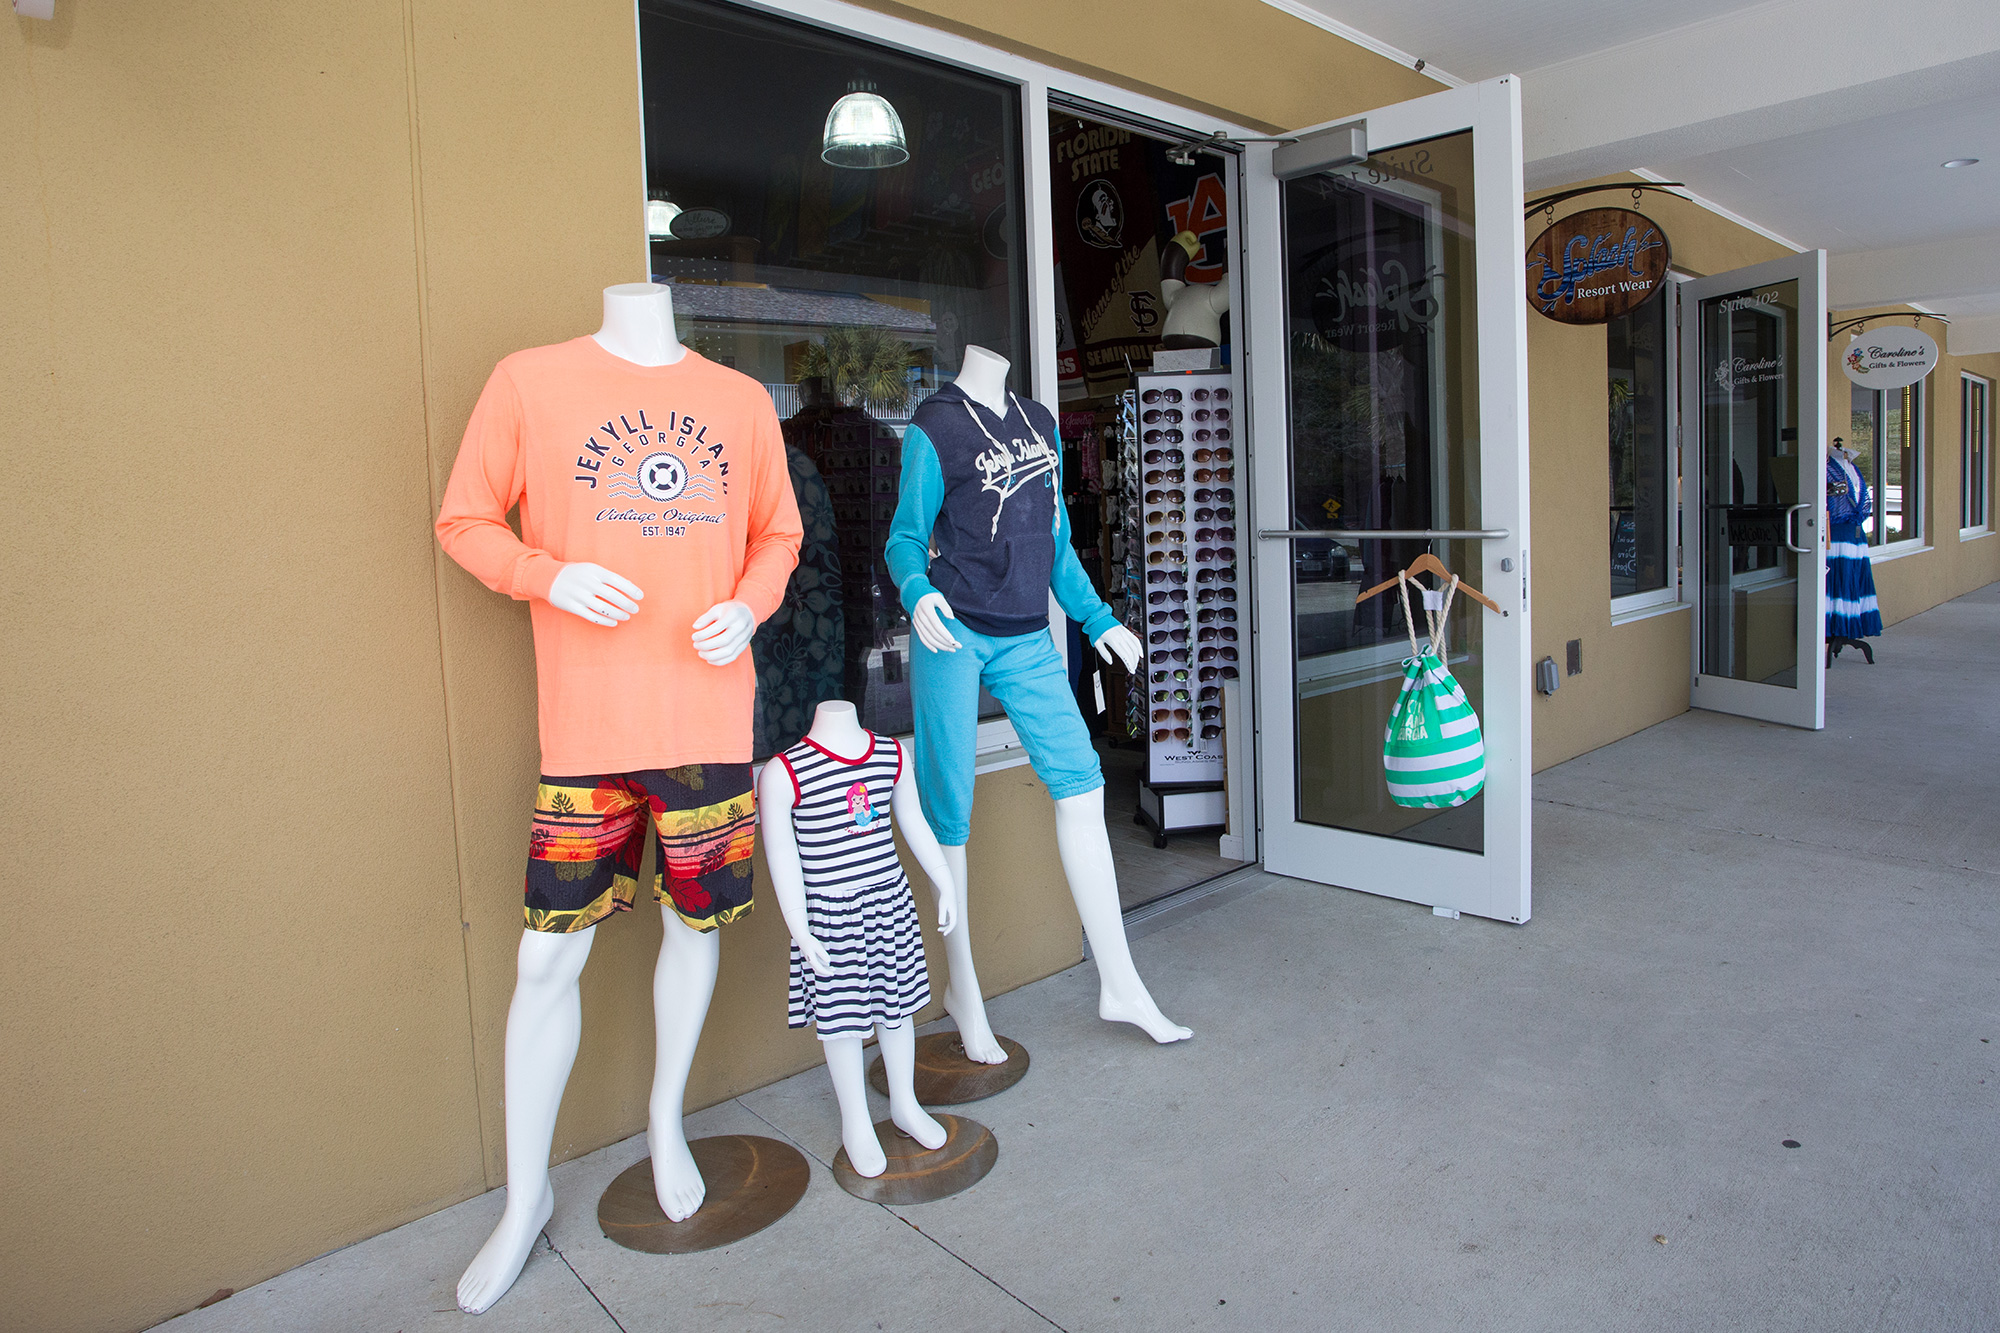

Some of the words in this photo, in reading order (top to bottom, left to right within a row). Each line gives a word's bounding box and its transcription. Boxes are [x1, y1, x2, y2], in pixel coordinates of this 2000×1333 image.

[1056, 127, 1131, 164] FLORIDA
[1071, 149, 1120, 183] STATE
[1121, 244, 1141, 275] the
[1536, 226, 1644, 305] Splash
[1577, 283, 1617, 299] Resort
[1619, 279, 1653, 293] Wear
[1719, 295, 1752, 314] Suite
[1755, 290, 1779, 307] 102
[1867, 345, 1926, 360] Caroline's
[1732, 354, 1784, 374] Caroline's
[1868, 362, 1887, 370] Gifts
[1897, 360, 1926, 368] Flowers
[1733, 376, 1751, 386] Gifts
[1751, 375, 1758, 384] &
[1758, 372, 1785, 383] Flowers
[575, 409, 654, 490] JEKYLL
[611, 431, 712, 470] GEORGIA
[595, 507, 658, 523] Vintage
[662, 507, 727, 524] Original
[642, 526, 663, 537] EST.
[665, 526, 687, 537] 1947
